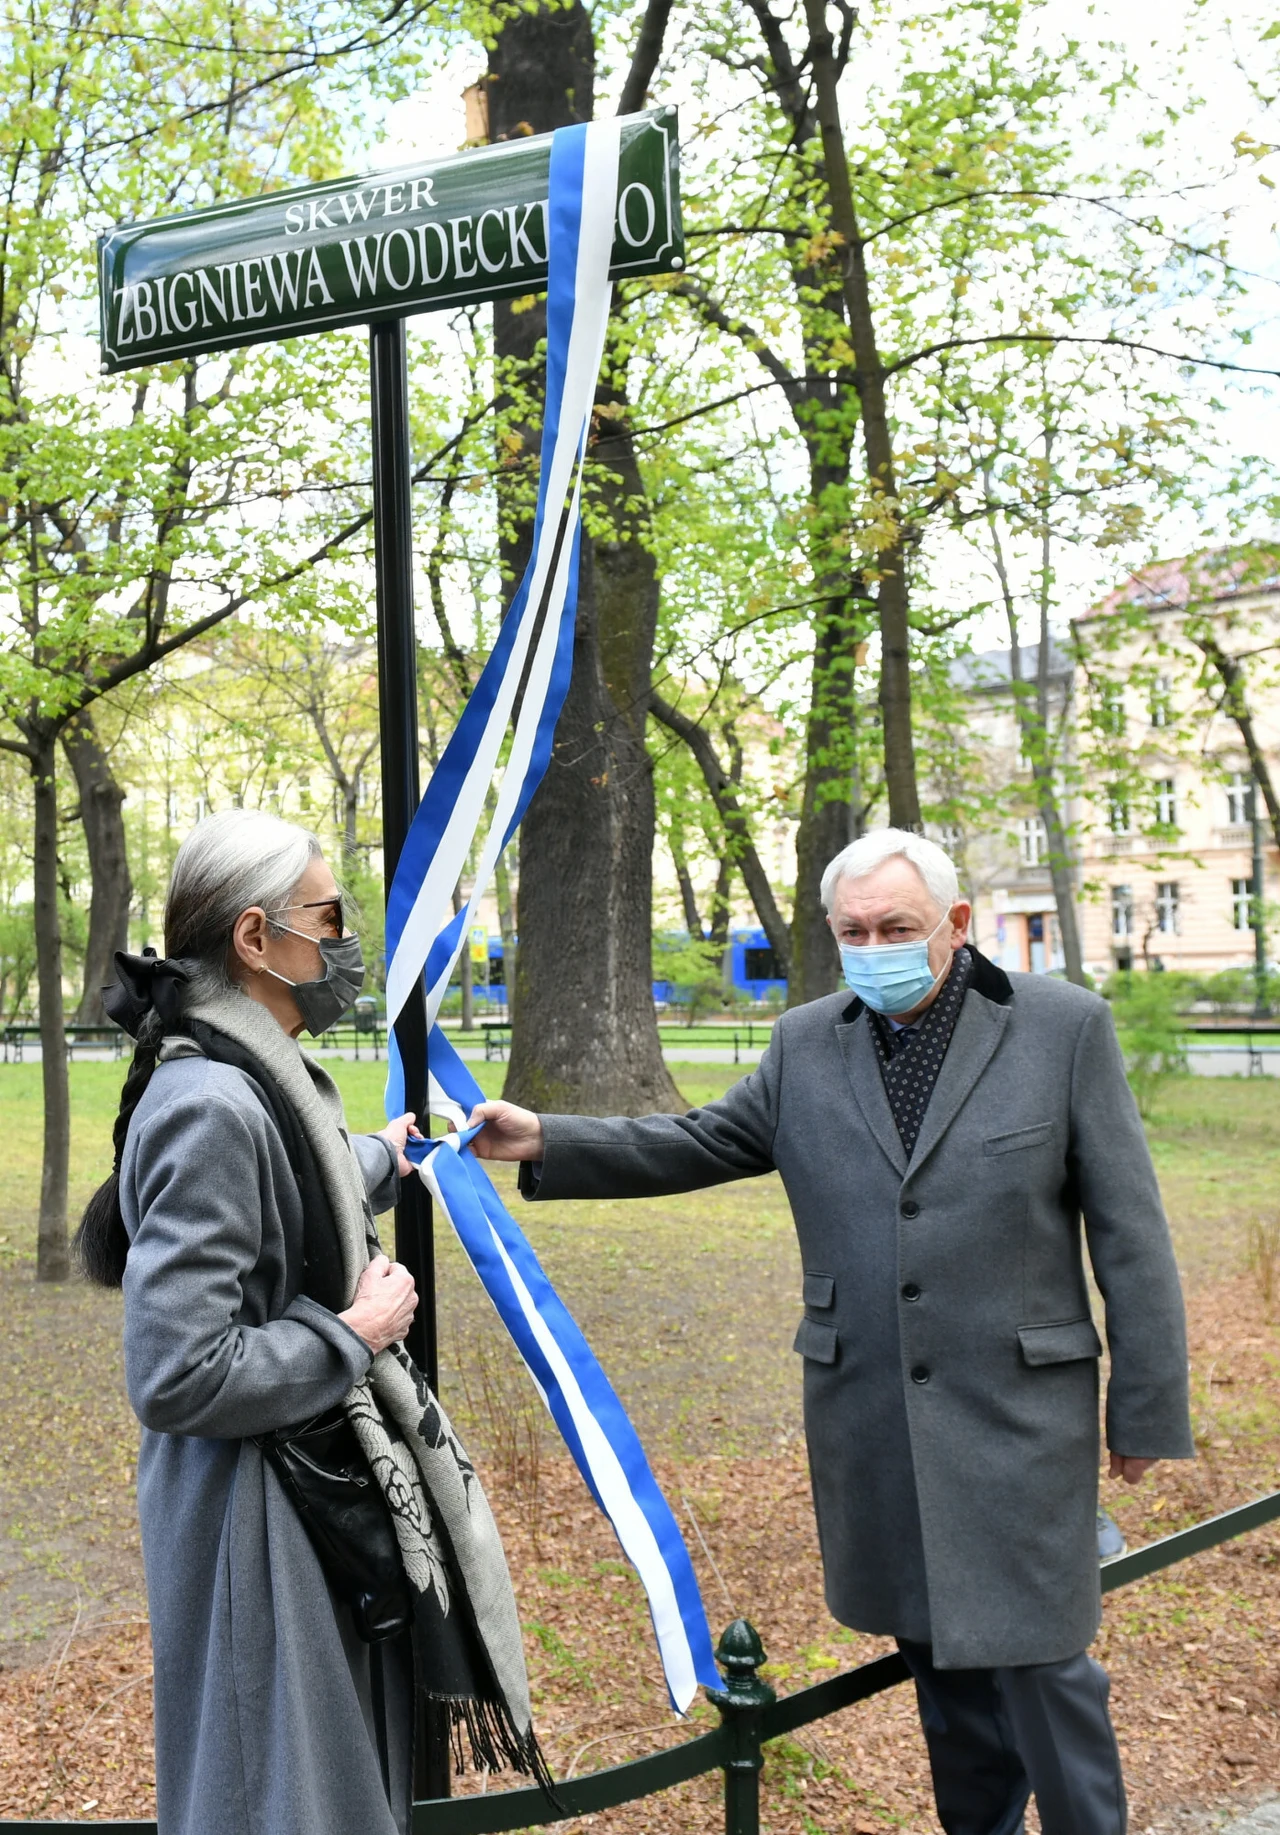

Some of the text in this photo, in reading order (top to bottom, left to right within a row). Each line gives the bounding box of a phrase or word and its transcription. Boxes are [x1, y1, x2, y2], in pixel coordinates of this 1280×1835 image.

[284, 177, 439, 236] SKWER
[113, 182, 656, 347] ZBIGNIEWA WODECKIO
